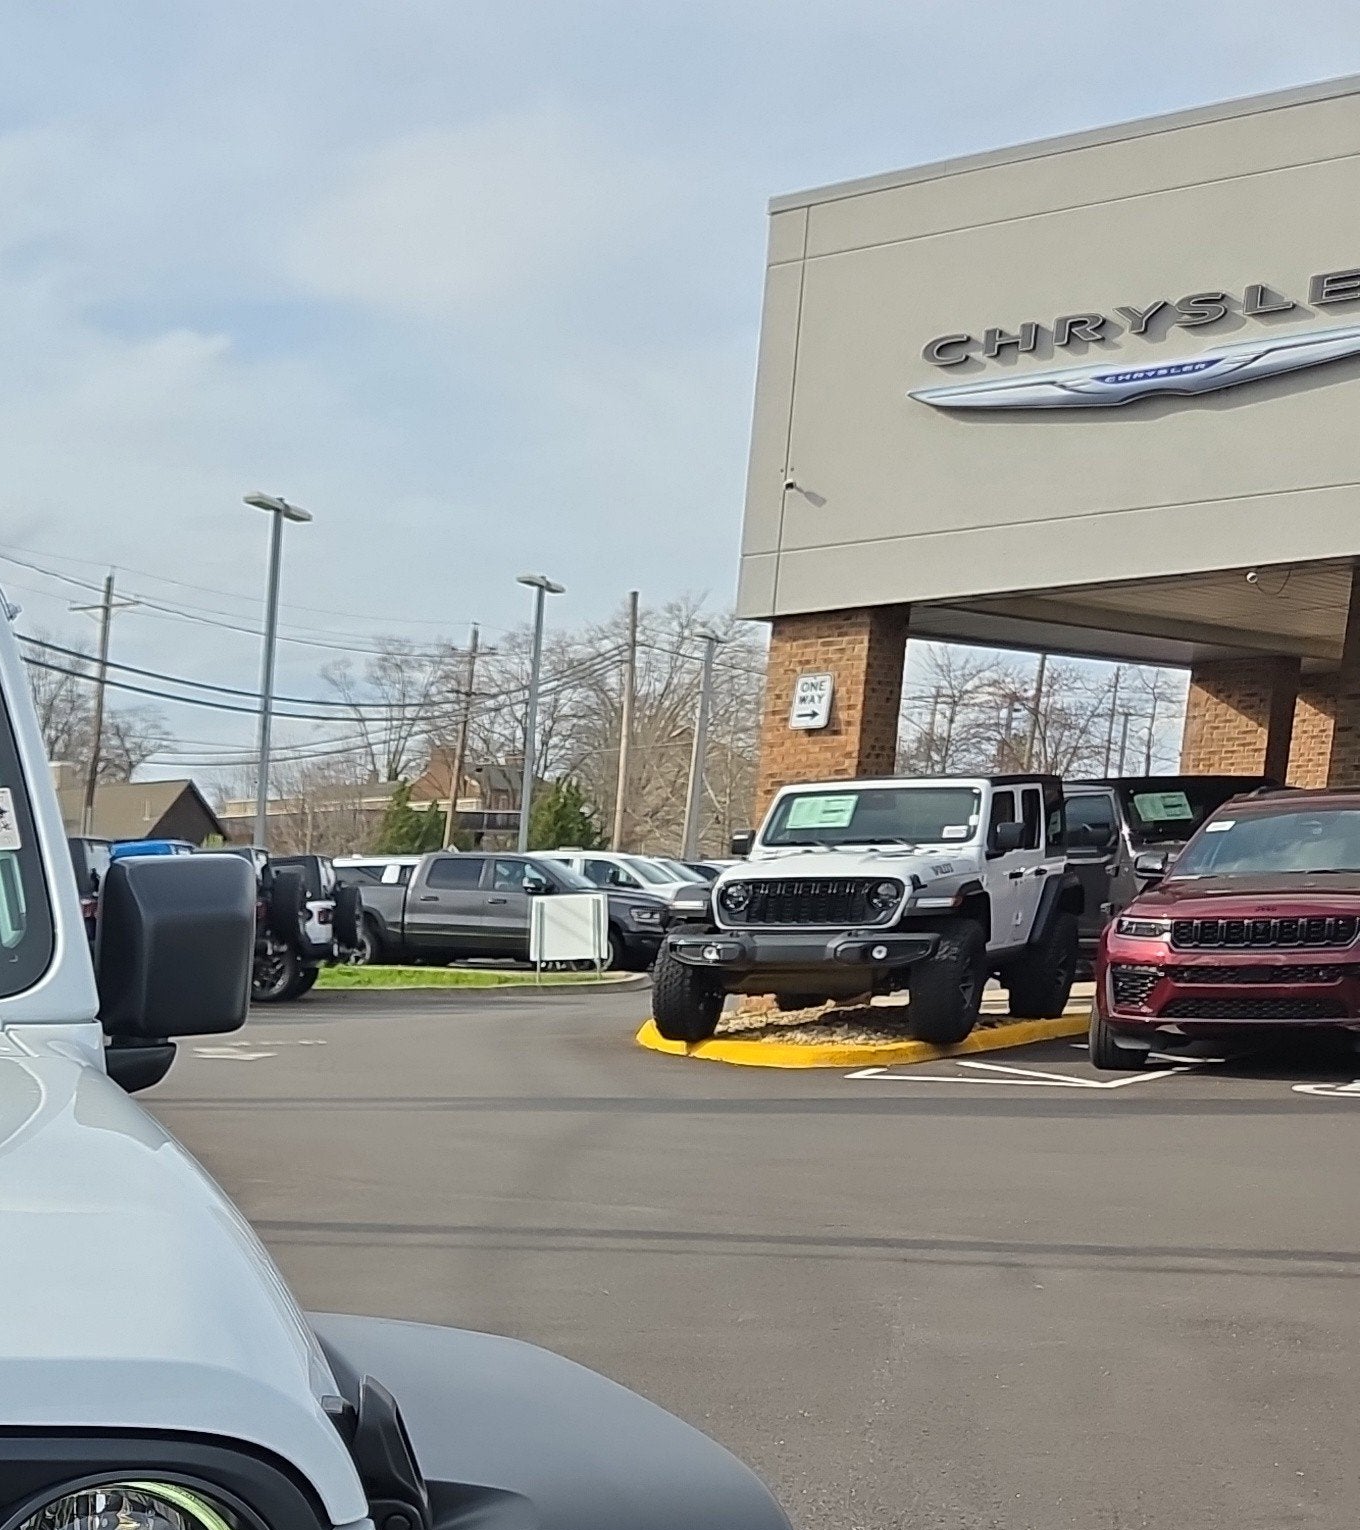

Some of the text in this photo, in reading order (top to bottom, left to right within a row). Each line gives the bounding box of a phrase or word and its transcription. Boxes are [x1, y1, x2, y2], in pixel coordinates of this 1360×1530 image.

[922, 267, 1360, 367] CHRYSLE
[1104, 363, 1206, 383] CHRYSLER
[800, 680, 826, 693] ONE
[799, 693, 825, 705] WAY
